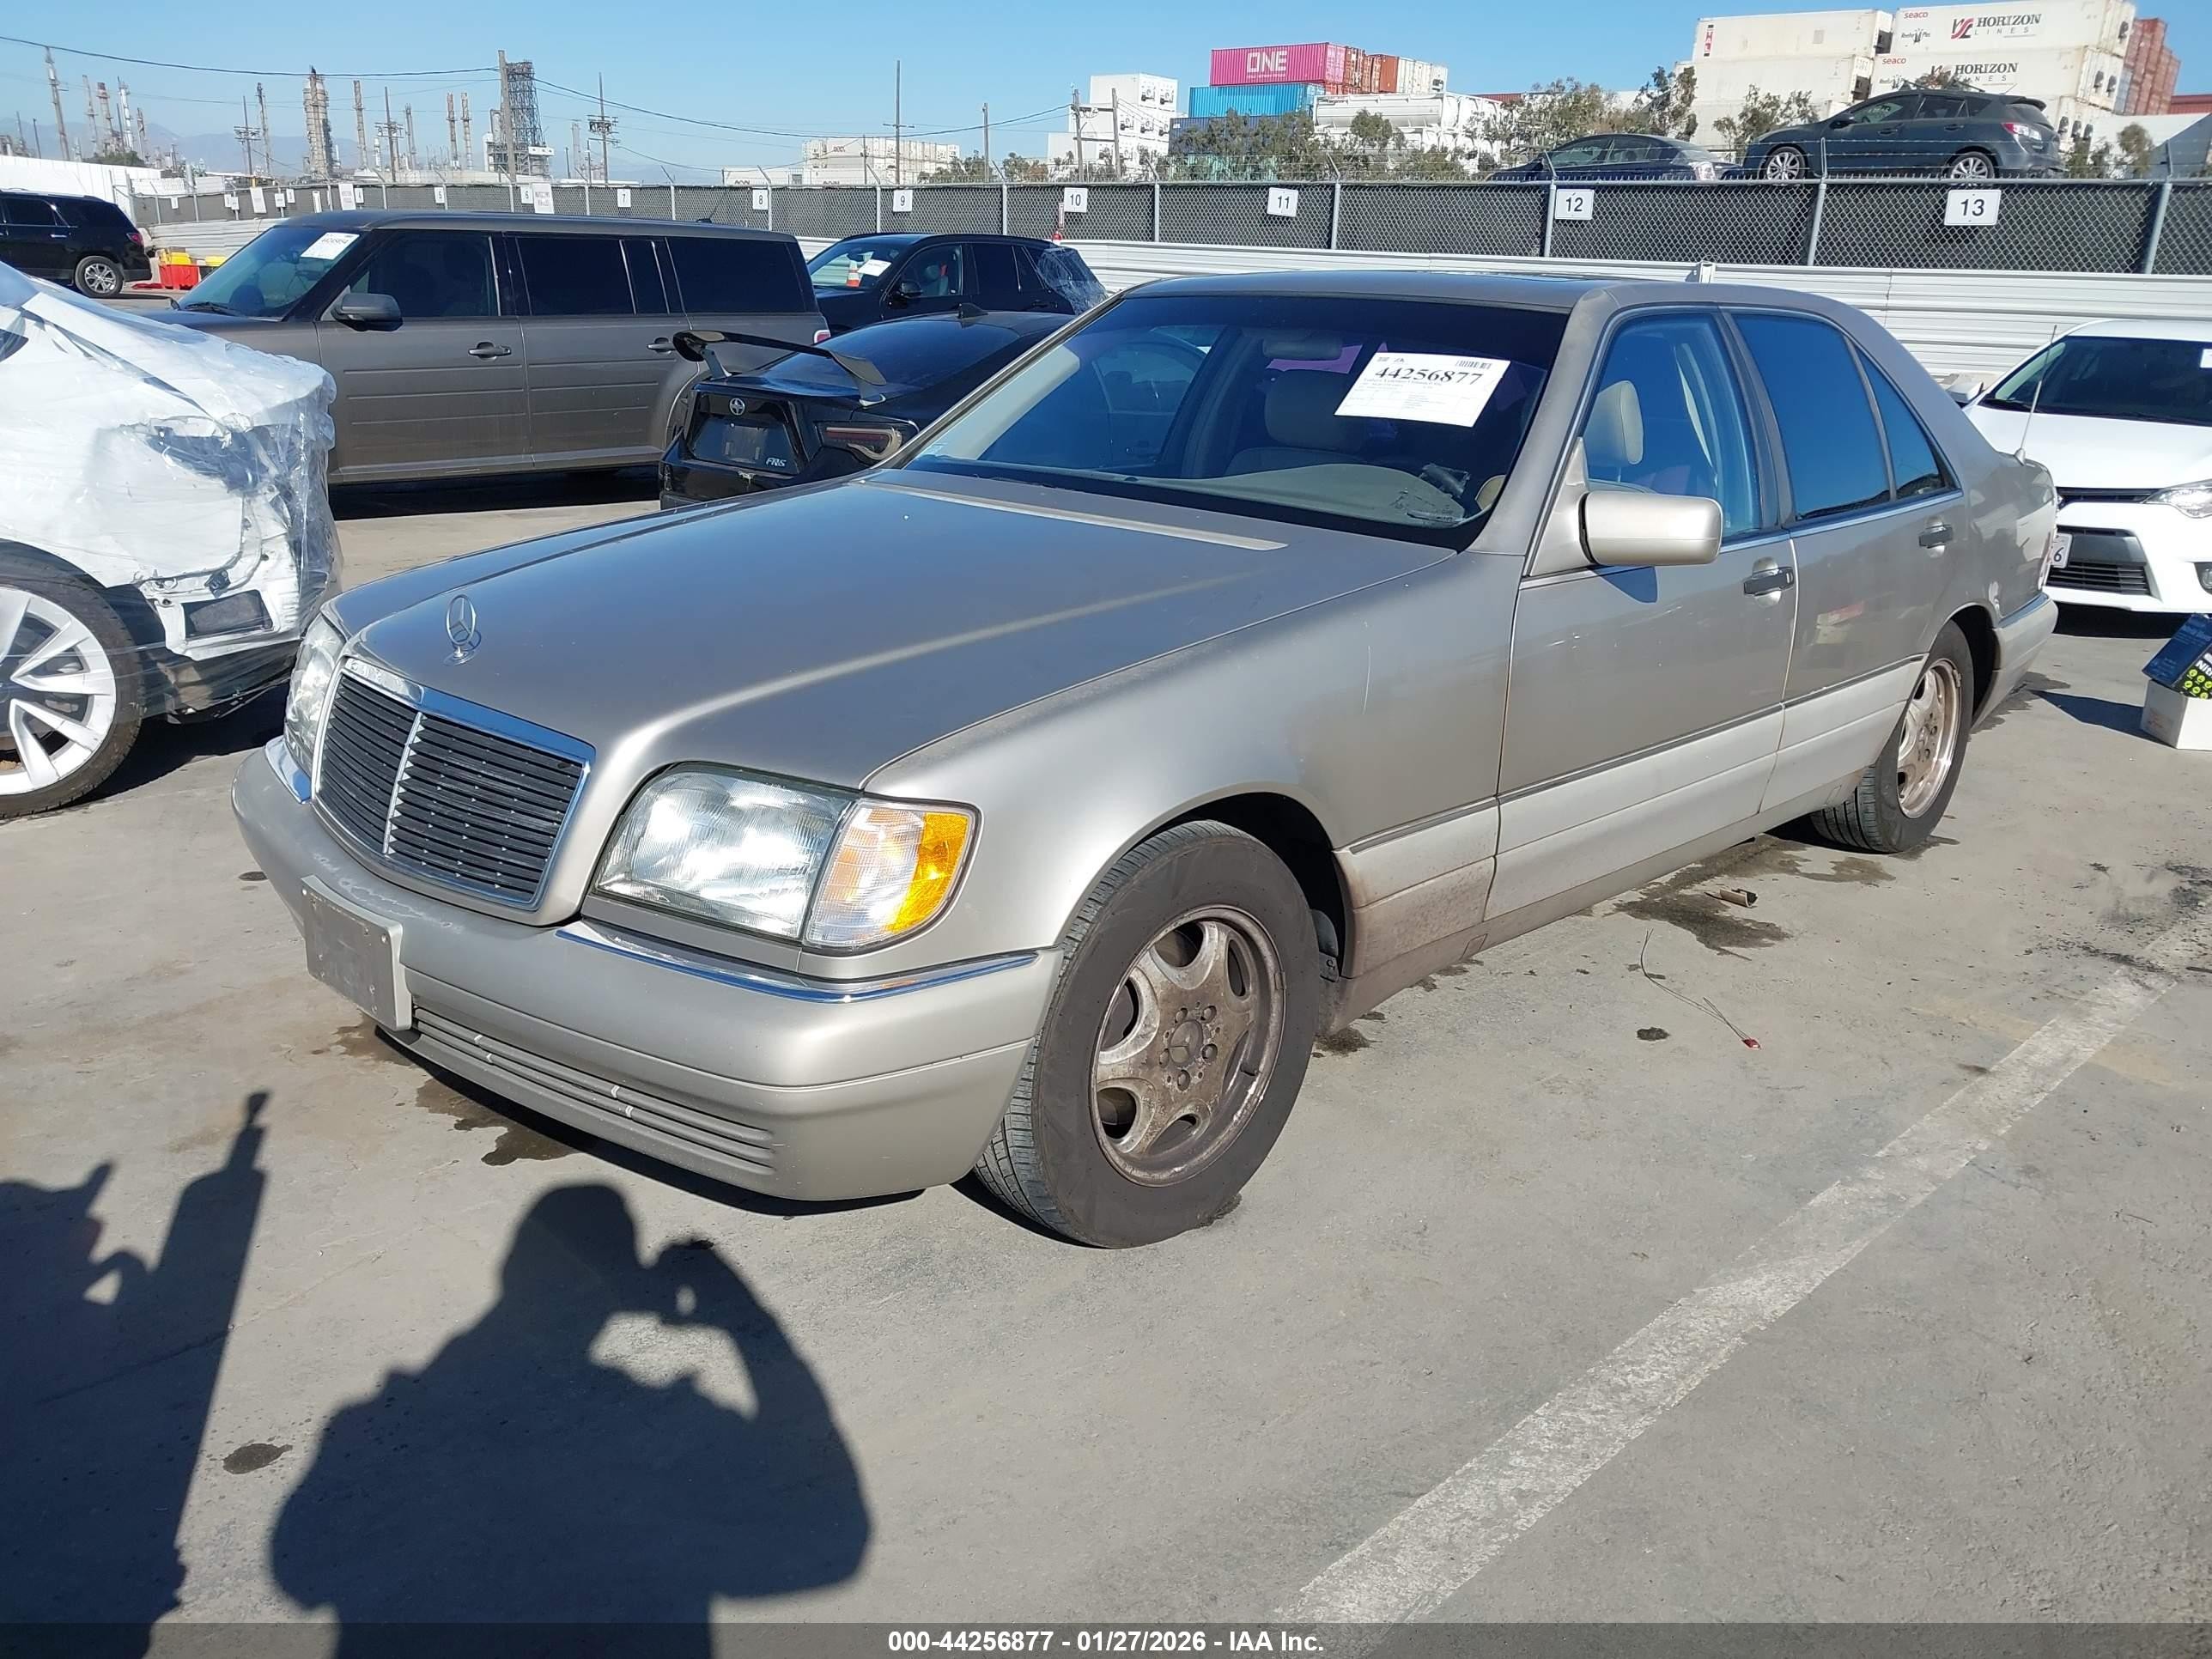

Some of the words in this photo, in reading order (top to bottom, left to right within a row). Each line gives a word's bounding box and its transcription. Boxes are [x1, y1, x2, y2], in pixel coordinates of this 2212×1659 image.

[1977, 14, 2042, 27] HORIZON
[1974, 27, 2029, 35] LINES
[1247, 51, 1287, 73] ONE
[1954, 63, 2019, 75] HORIZON
[621, 193, 627, 204] 7
[758, 194, 764, 205] 8
[900, 196, 906, 207] 9
[1070, 193, 1081, 207] 10
[1277, 195, 1290, 210] 11
[1565, 197, 1583, 212] 12
[1960, 198, 1985, 217] 13
[1375, 367, 1484, 385] 44256877
